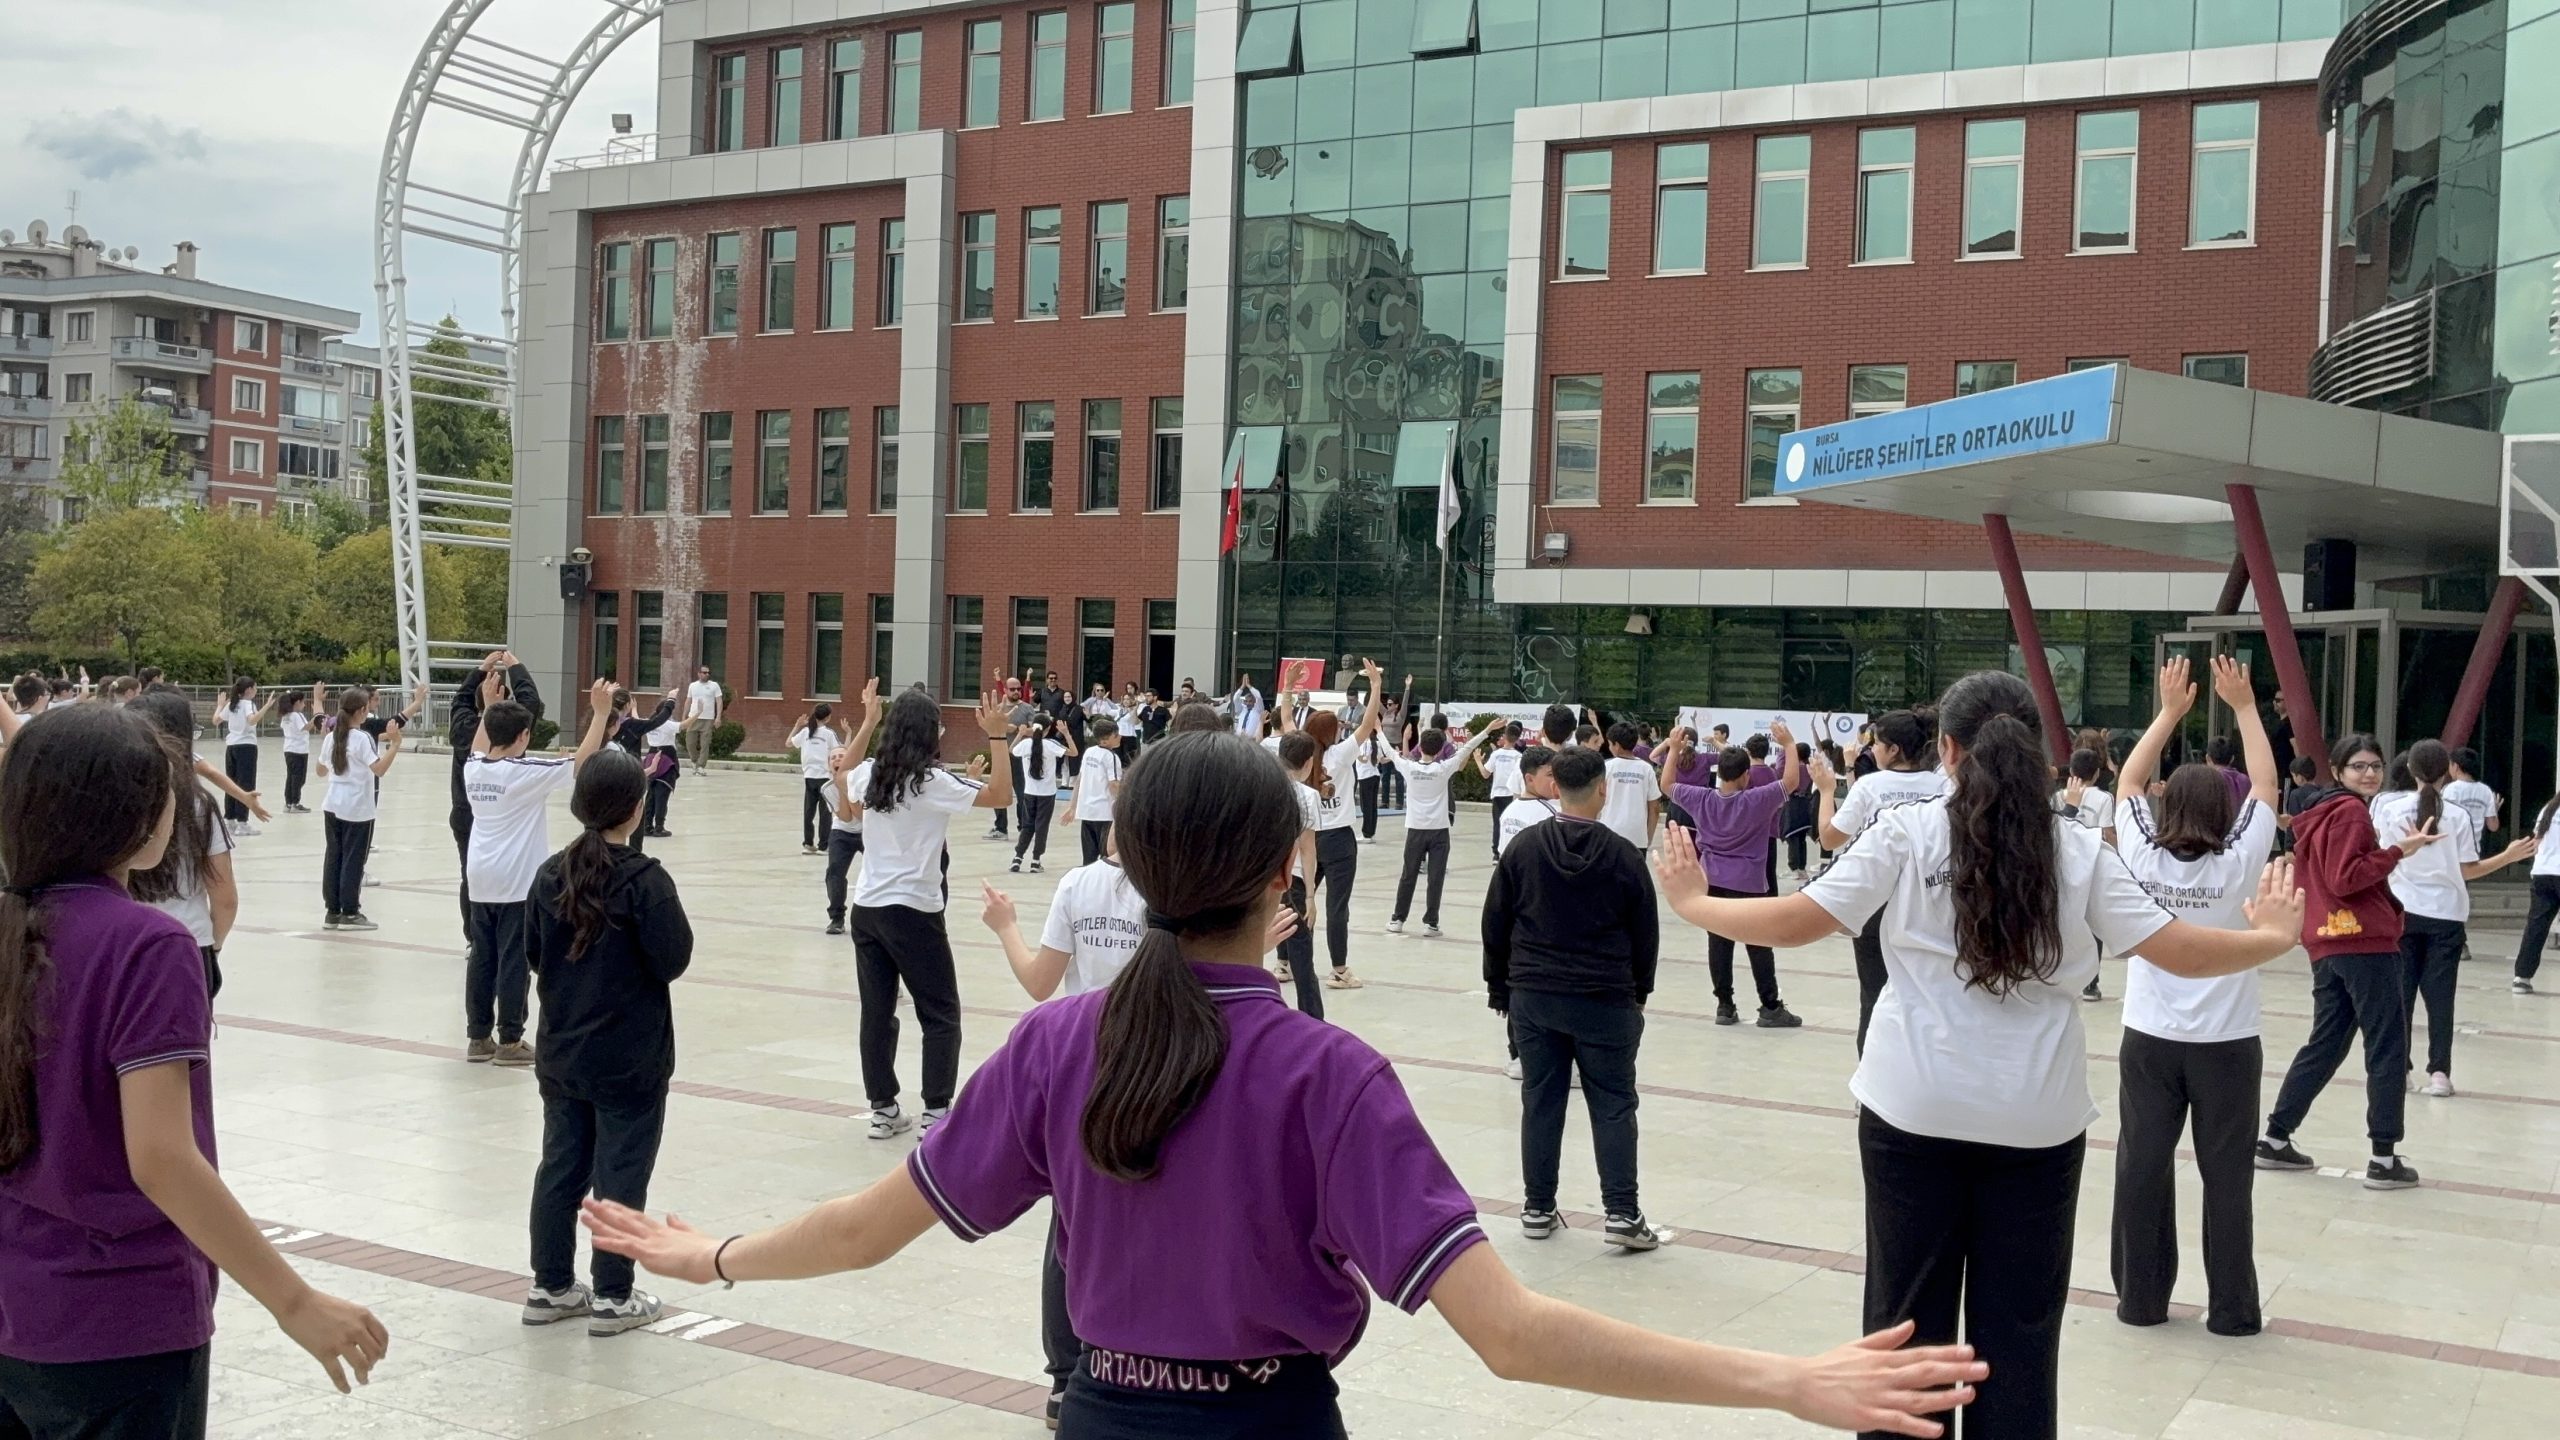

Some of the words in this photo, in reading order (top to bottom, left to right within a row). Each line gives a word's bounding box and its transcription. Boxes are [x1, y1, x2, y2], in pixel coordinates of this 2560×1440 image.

[1813, 447, 1873, 477] NİLÜFER
[1877, 433, 1956, 470] ŞEHİTLER
[1962, 410, 2075, 452] ORTAOKULU
[1816, 432, 1839, 447] BURSA
[1925, 870, 1954, 888] NİLÜFE
[2175, 887, 2223, 899] ORTAOKULU
[1109, 917, 1143, 937] ORTAOKU
[1082, 934, 1138, 949] NİLÜFER
[1090, 1349, 1230, 1392] ORTAOKULU
